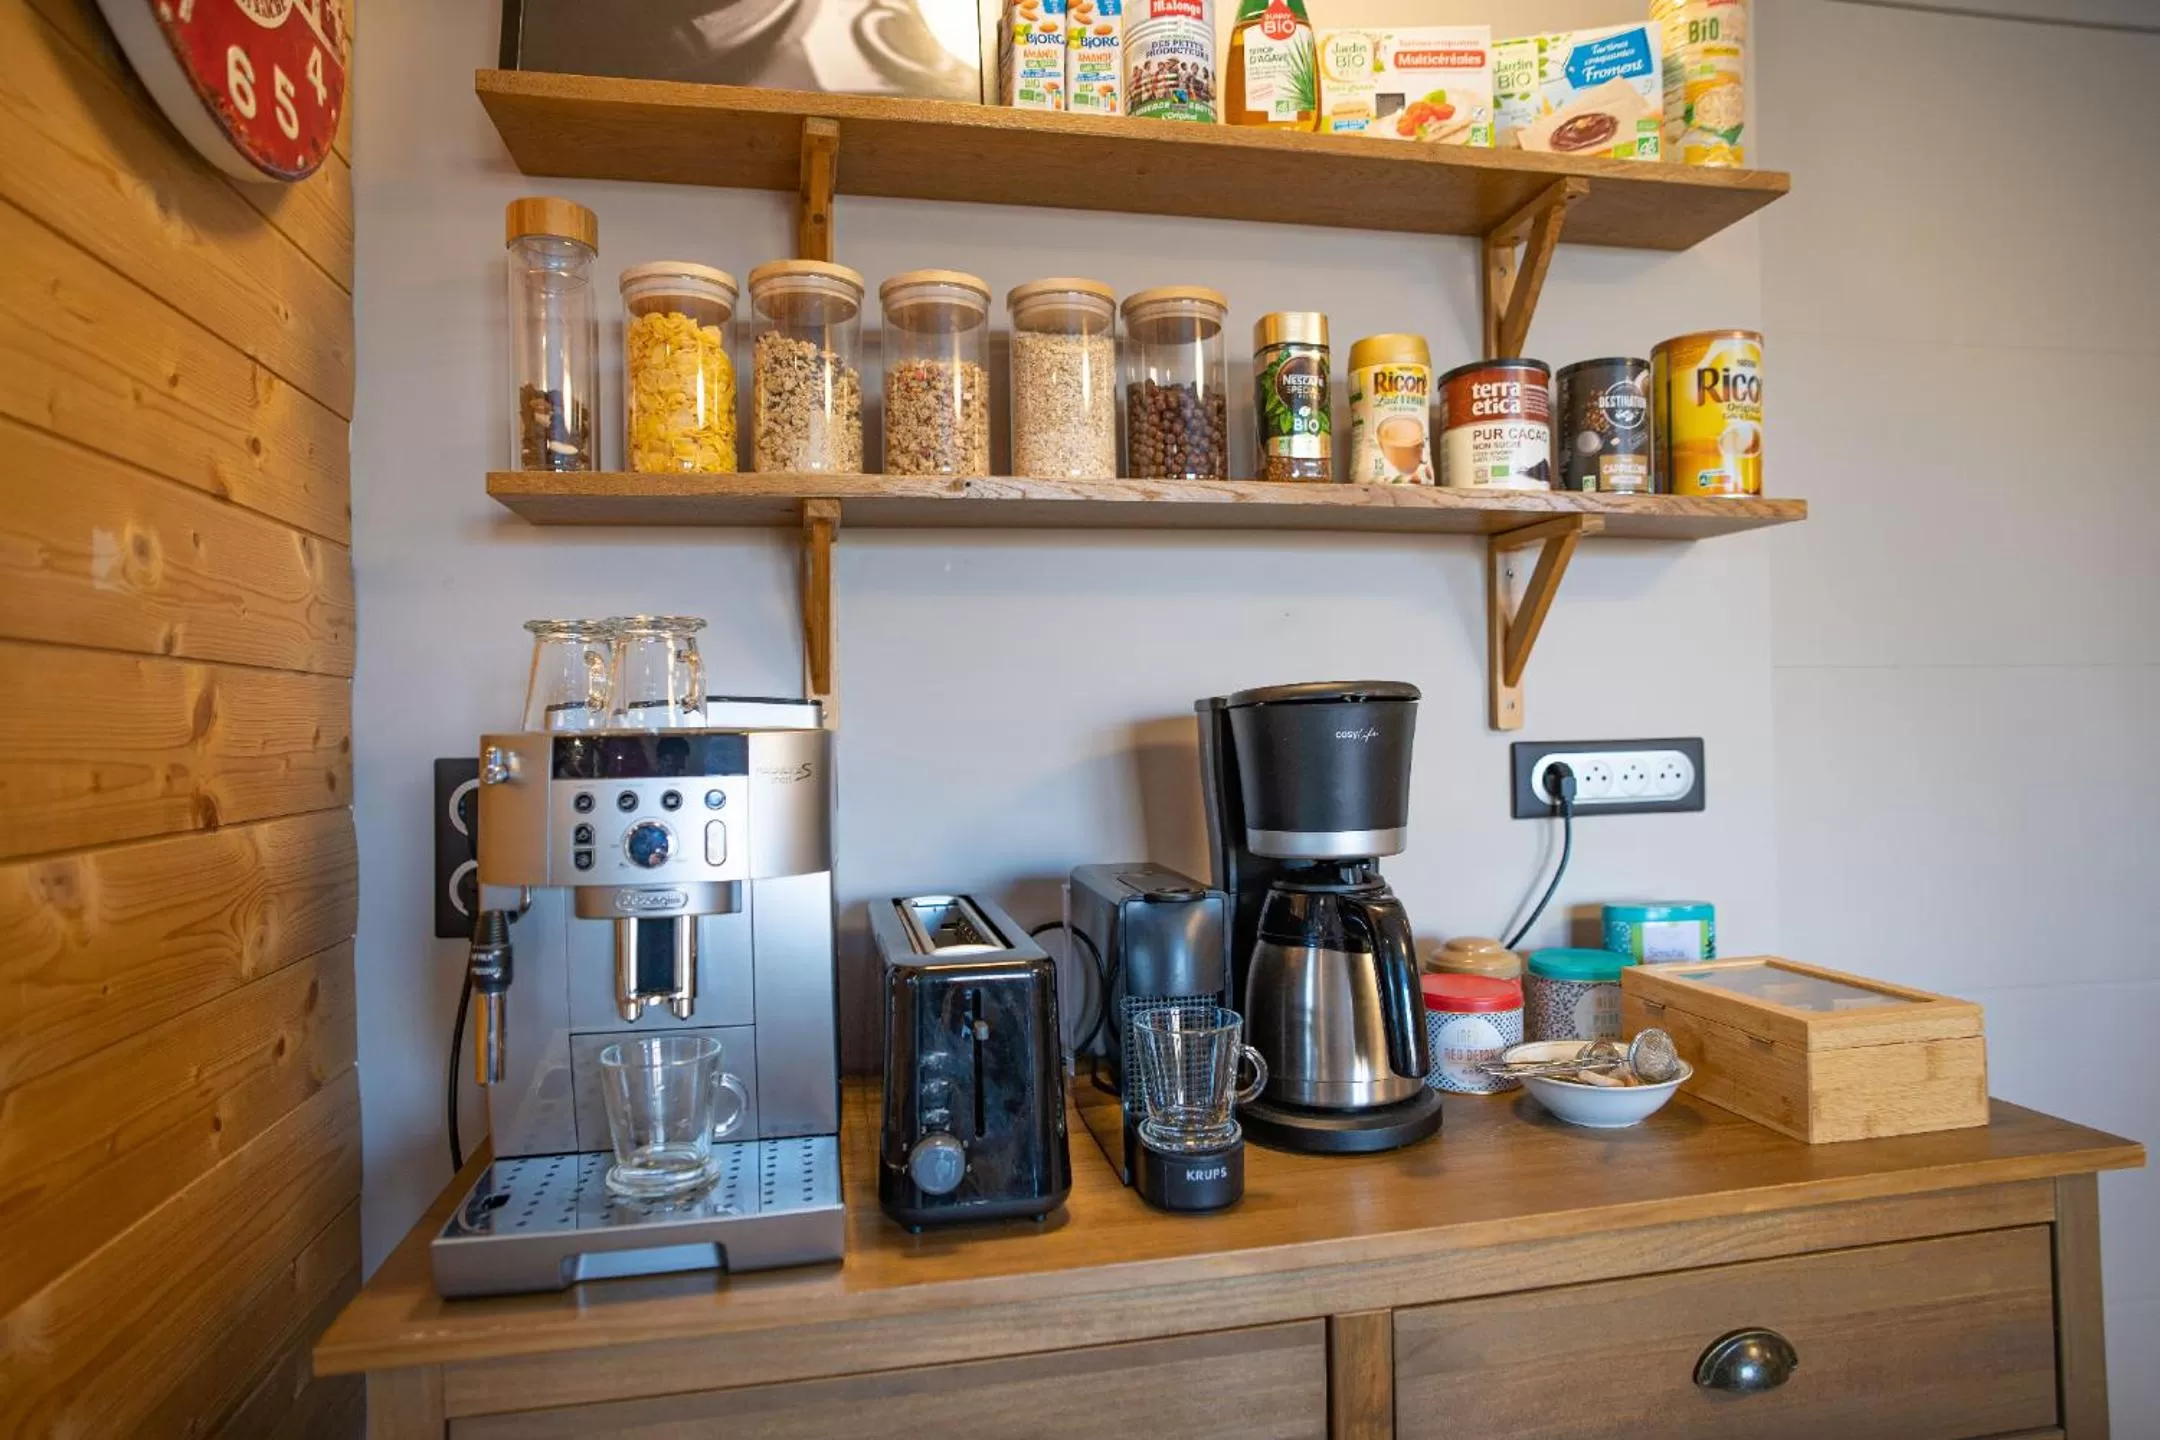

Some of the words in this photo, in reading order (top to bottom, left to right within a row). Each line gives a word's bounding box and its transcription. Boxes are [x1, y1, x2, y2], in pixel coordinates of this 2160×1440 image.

[1264, 20, 1295, 34] BIO
[1332, 42, 1368, 55] Jardin
[1399, 52, 1483, 66] Multicéréales
[1494, 58, 1533, 74] Jardin
[306, 46, 328, 107] 4
[1582, 59, 1644, 83] Froment
[227, 44, 257, 119] 6
[274, 64, 299, 140] 5
[1472, 381, 1522, 400] terra
[1472, 399, 1522, 417] etica
[1293, 417, 1320, 434] BIO
[1473, 429, 1503, 442] PUR
[1186, 1166, 1228, 1182] KRUPS
